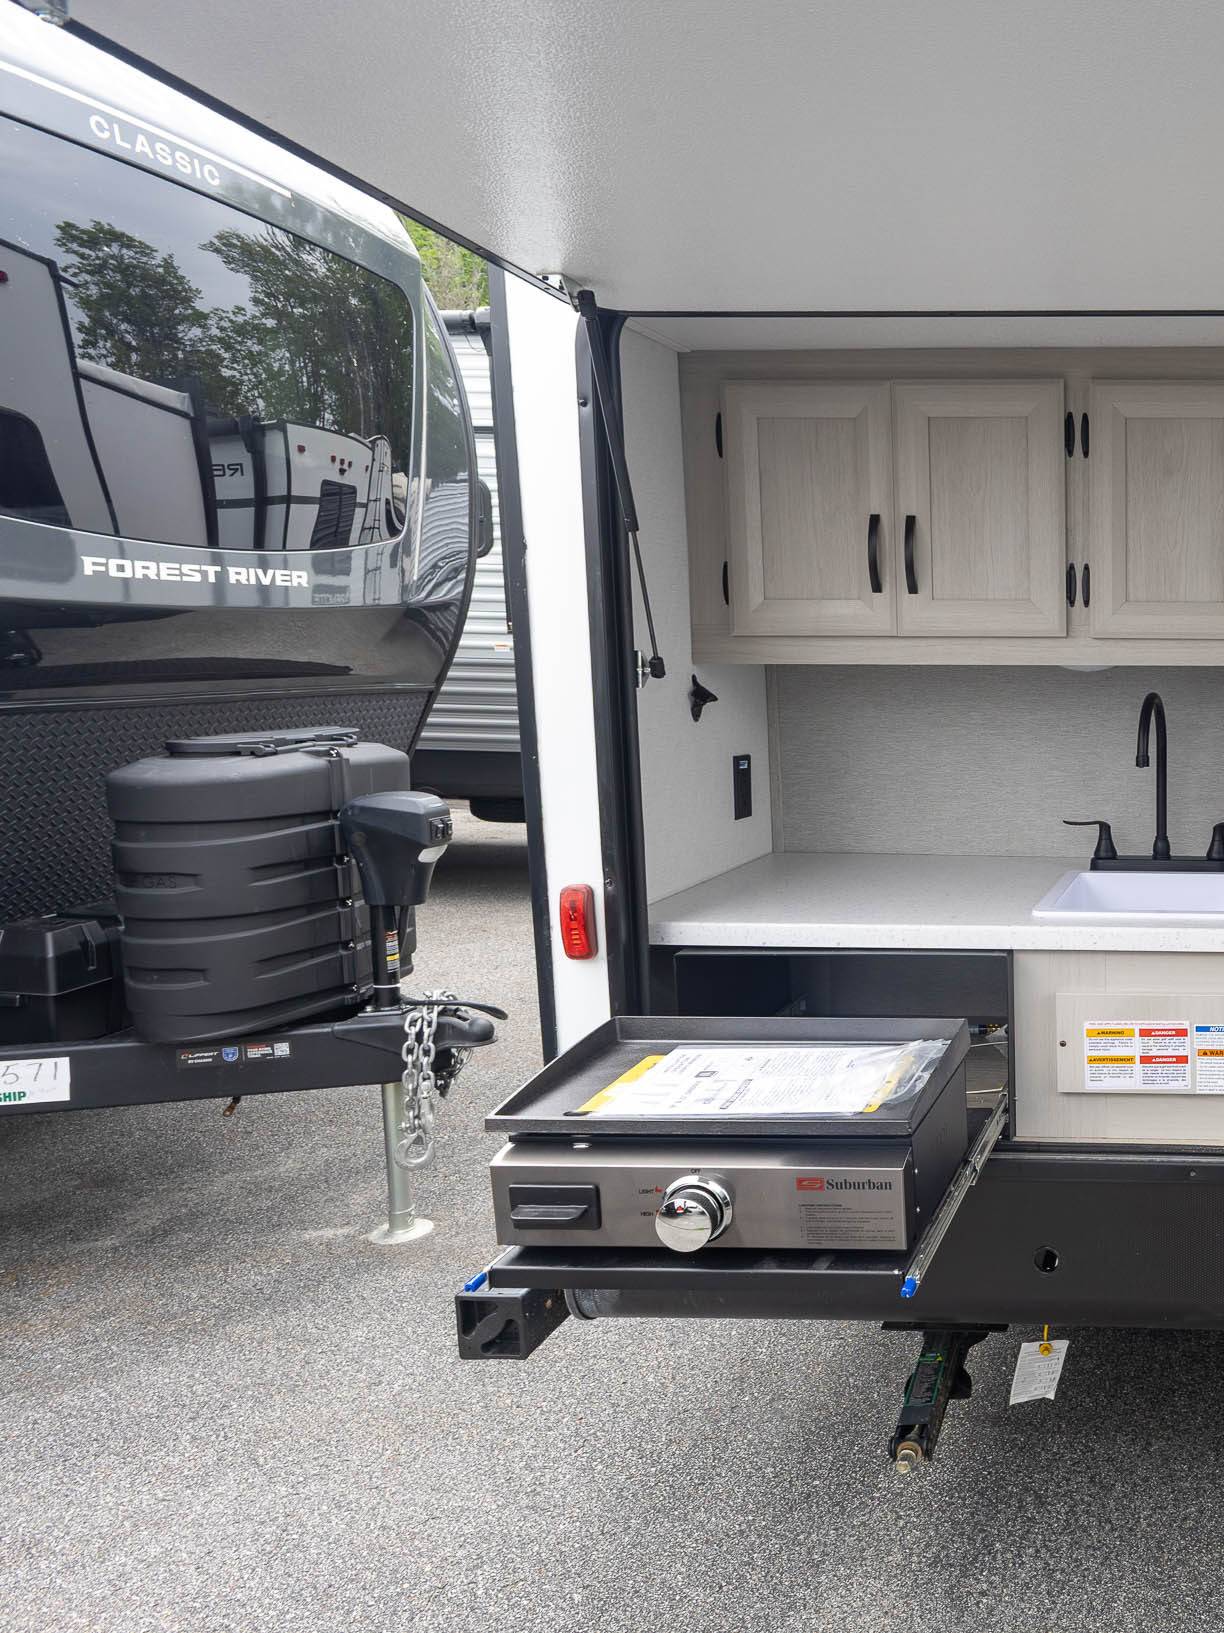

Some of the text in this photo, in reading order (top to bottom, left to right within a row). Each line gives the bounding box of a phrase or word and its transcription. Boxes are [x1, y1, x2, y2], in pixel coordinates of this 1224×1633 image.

[88, 114, 221, 186] CLASSIC
[80, 556, 309, 587] FOREST RIVER
[143, 875, 177, 888] GAS
[826, 1178, 893, 1191] Suburban
